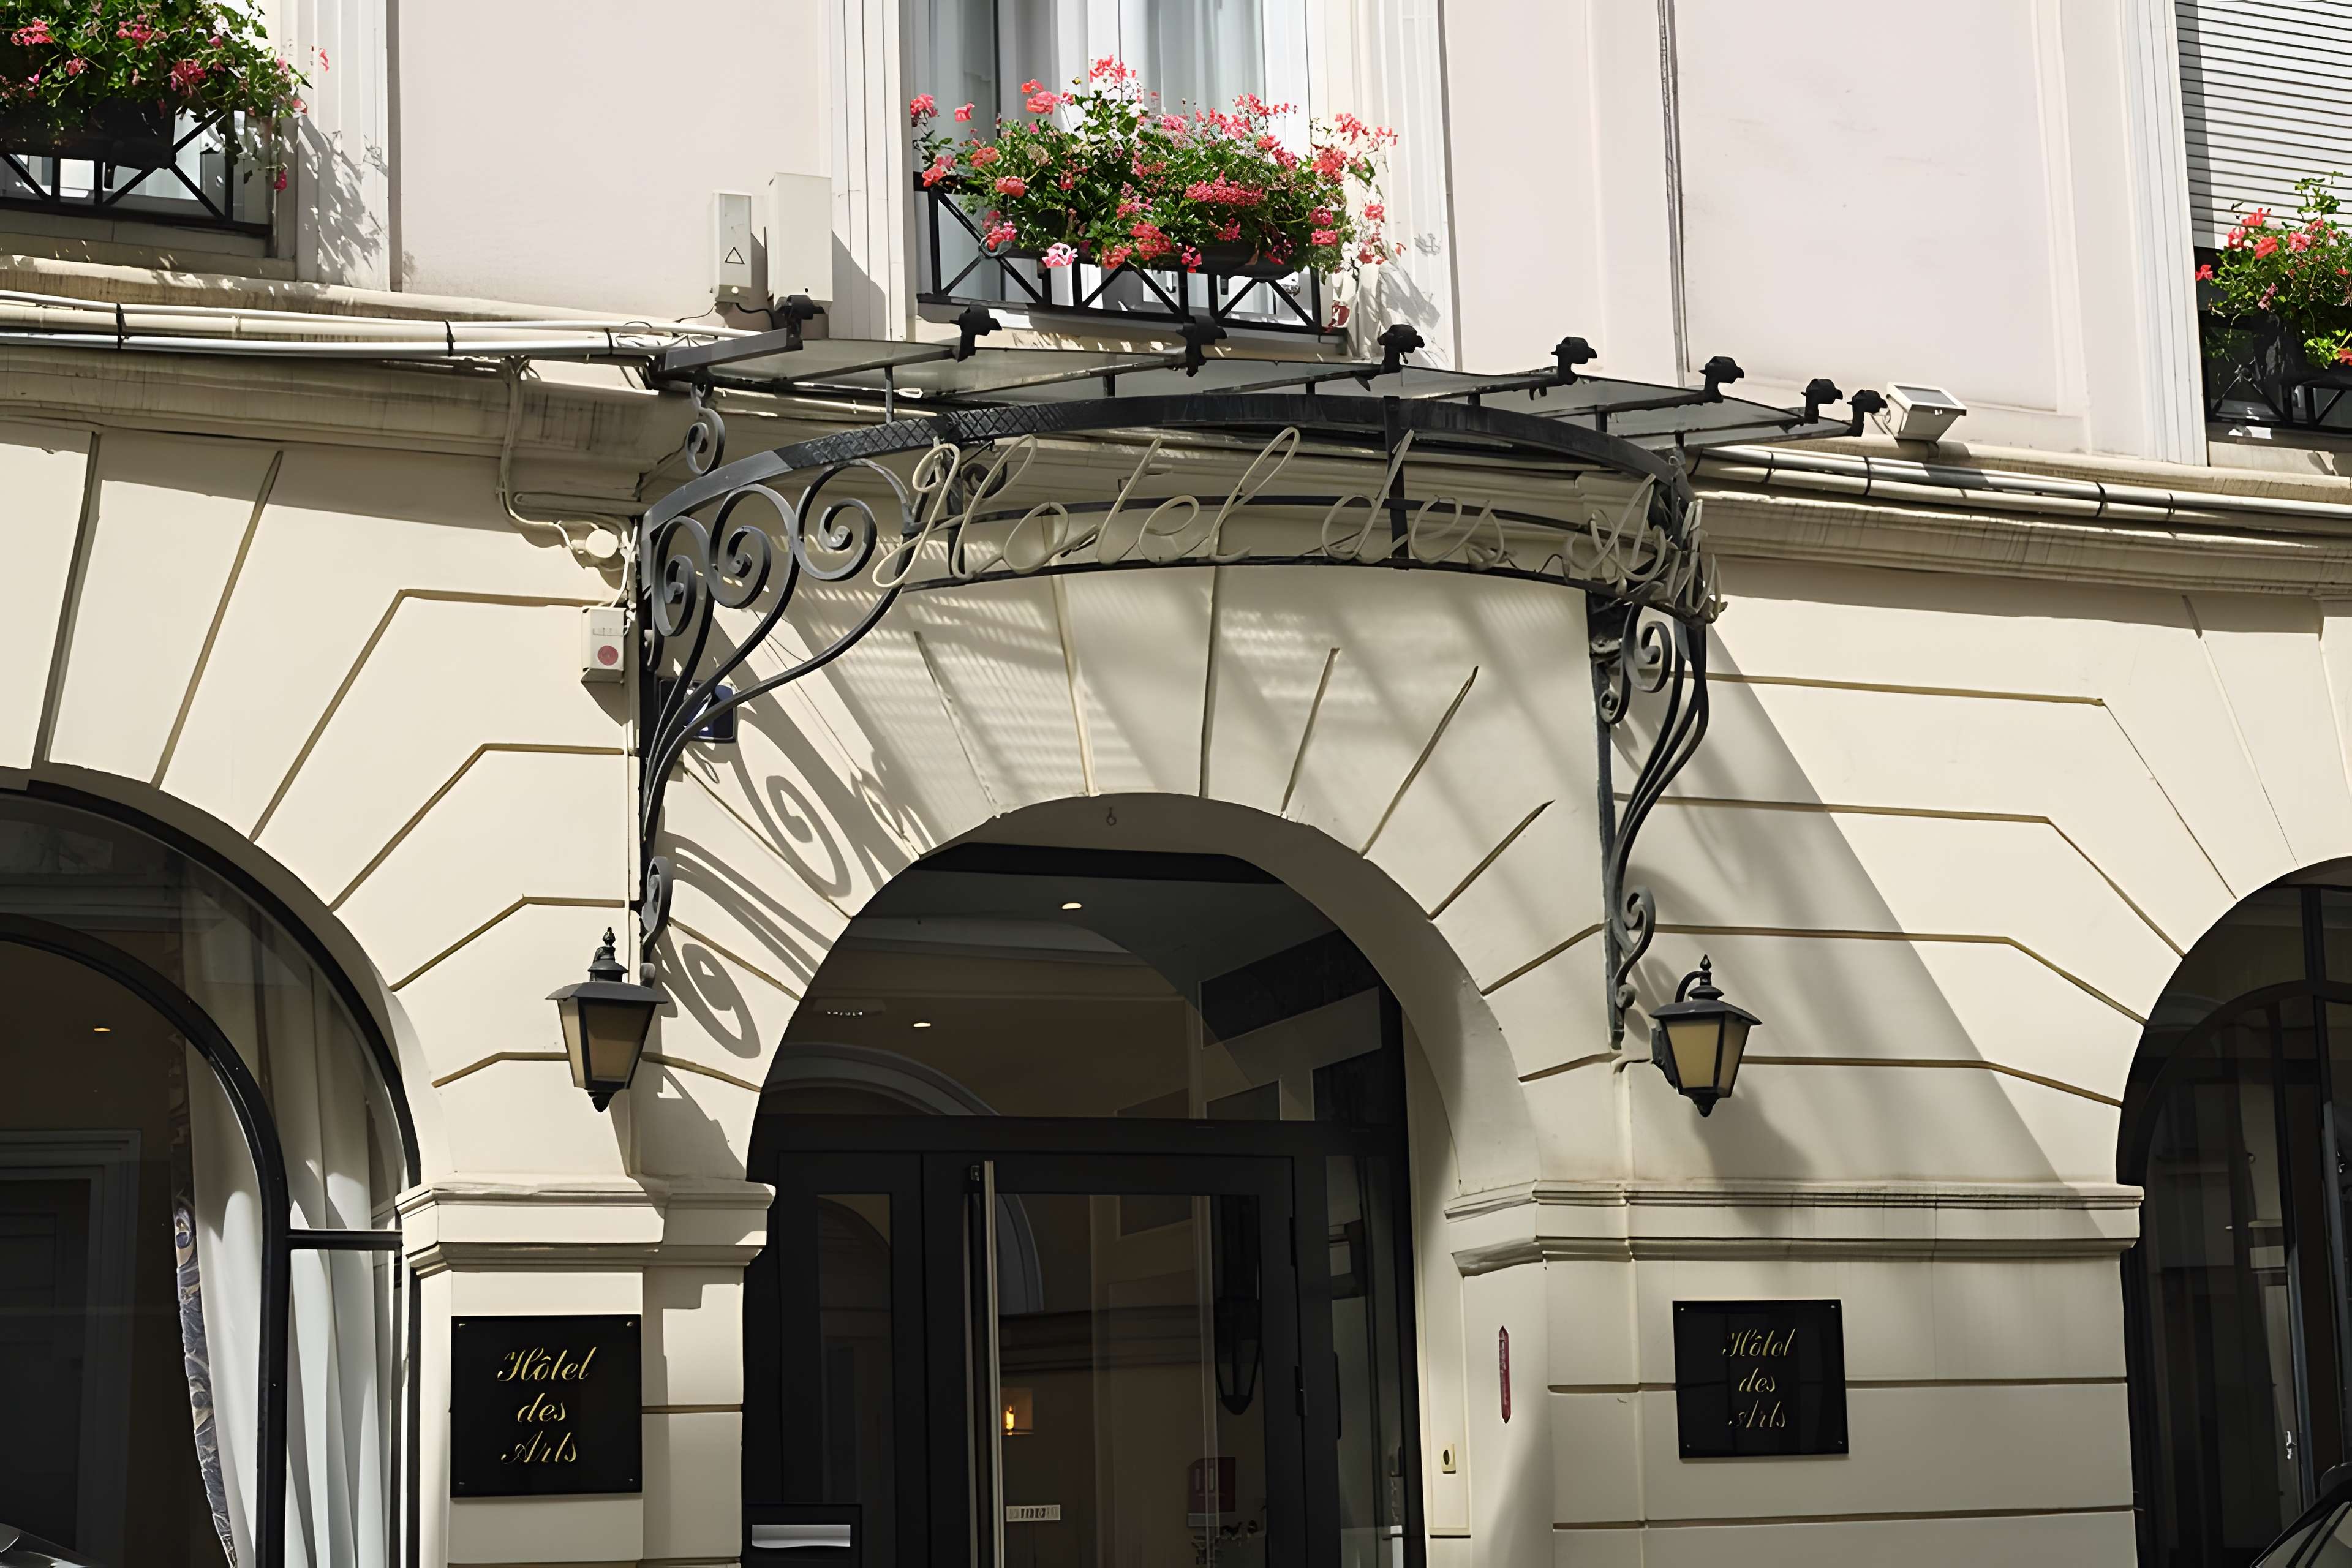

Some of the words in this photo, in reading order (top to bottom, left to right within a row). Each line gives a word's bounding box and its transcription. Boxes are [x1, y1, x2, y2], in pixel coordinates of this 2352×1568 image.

[1319, 428, 1506, 572] des
[1721, 1327, 1796, 1357] Hôtel
[497, 1346, 597, 1382] Hôtel
[1738, 1366, 1776, 1392] des
[517, 1392, 567, 1423] des
[1728, 1400, 1786, 1428] Arts
[500, 1430, 577, 1464] Arts
